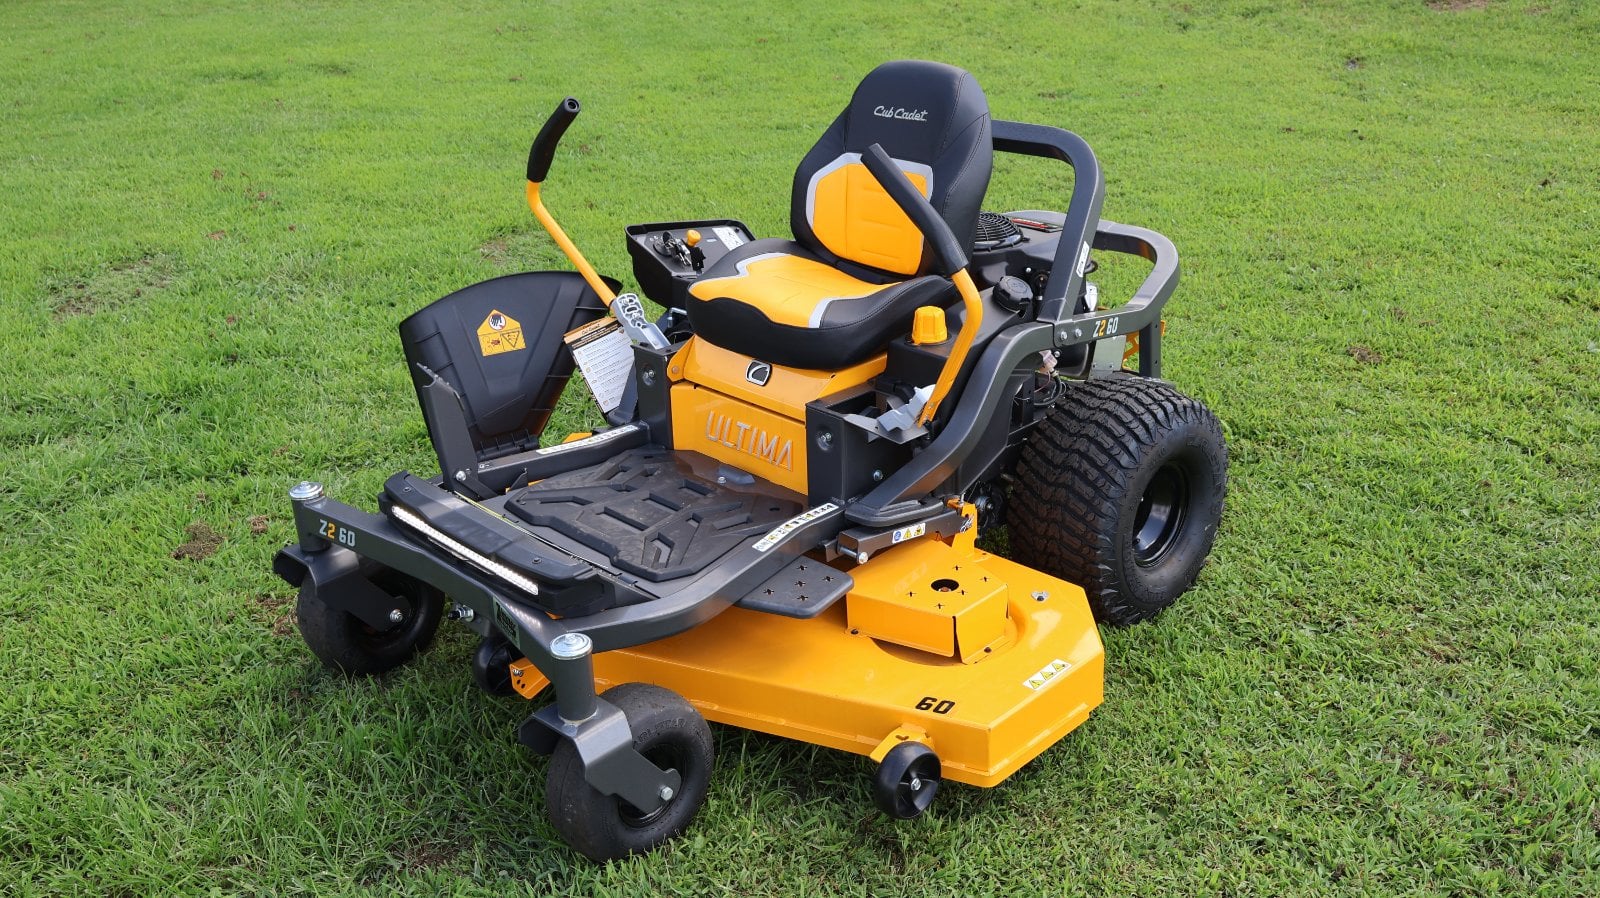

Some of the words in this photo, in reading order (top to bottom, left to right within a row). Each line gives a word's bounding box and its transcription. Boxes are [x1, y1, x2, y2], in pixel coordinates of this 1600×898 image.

[874, 105, 894, 118] Cub
[894, 108, 928, 121] Cadet
[1093, 320, 1106, 337] Z2
[1106, 317, 1119, 335] 60
[706, 410, 793, 472] ULTIMA
[319, 518, 336, 540] Z2
[339, 527, 356, 547] 60
[915, 696, 956, 715] 60
